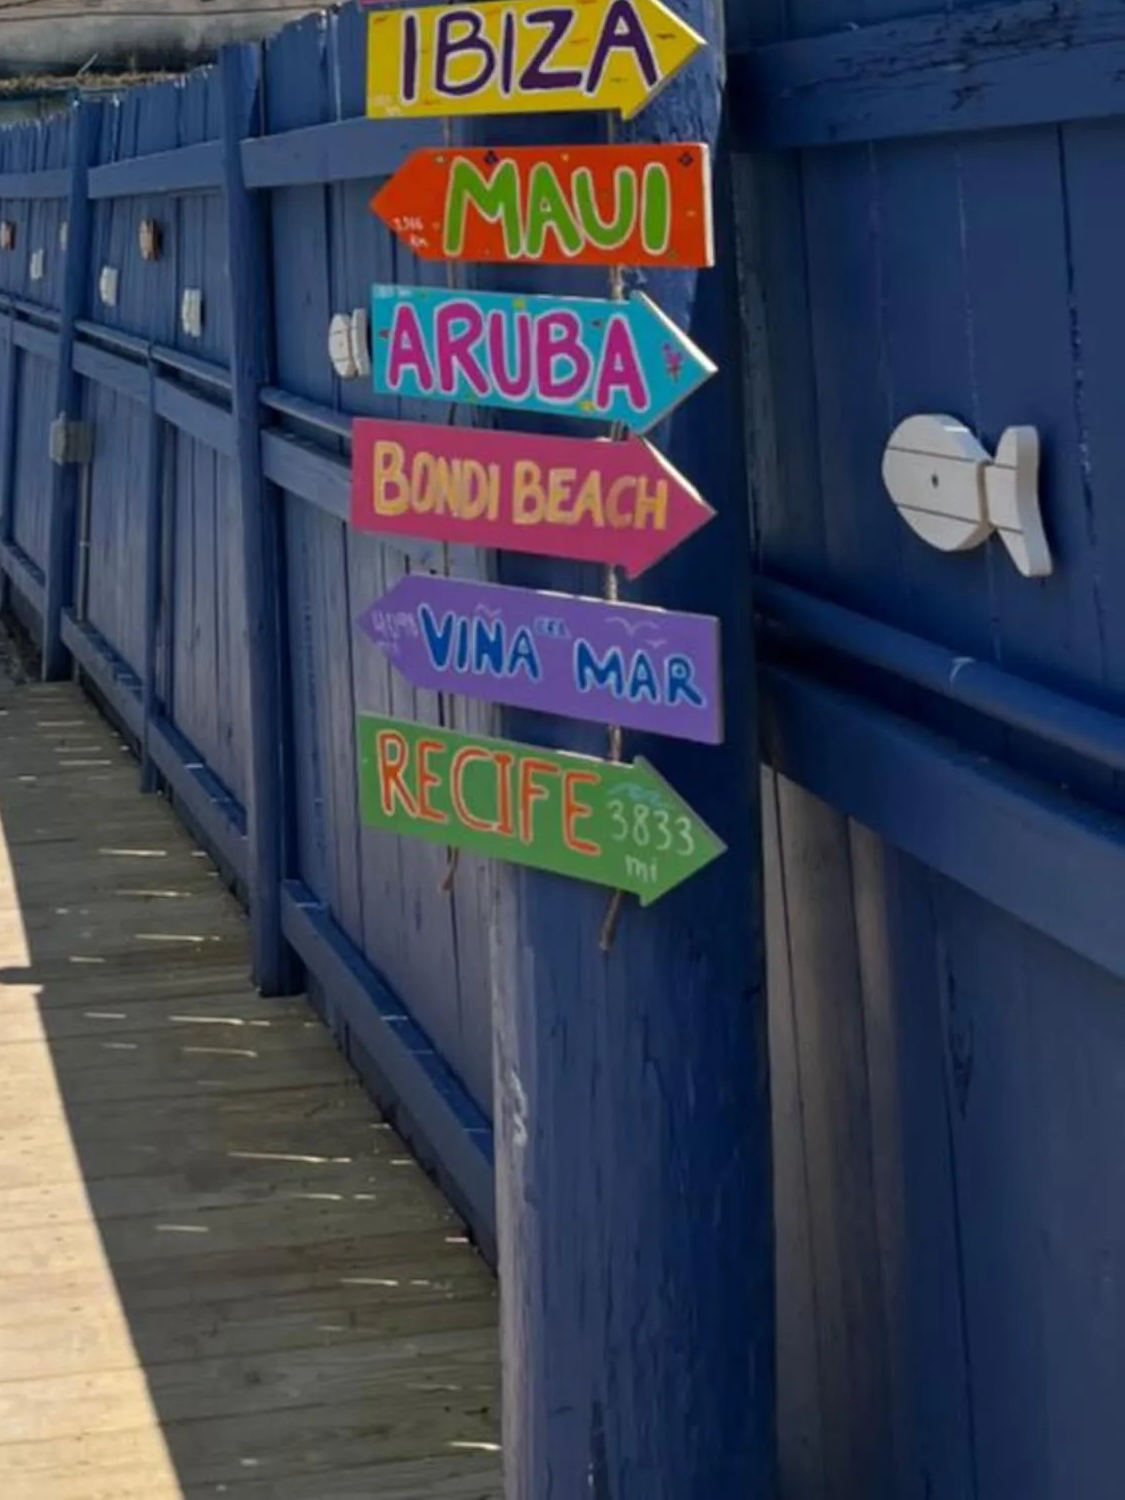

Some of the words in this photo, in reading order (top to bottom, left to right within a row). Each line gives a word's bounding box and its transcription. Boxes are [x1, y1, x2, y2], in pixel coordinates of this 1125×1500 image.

[443, 156, 671, 259] MAUI
[386, 299, 650, 412] ARUBA
[374, 441, 501, 520] BONDI
[512, 460, 668, 531] BEACH
[573, 638, 706, 706] MAR
[377, 729, 601, 856] RECIFE
[606, 799, 695, 856] 3833
[624, 853, 659, 883] mi
